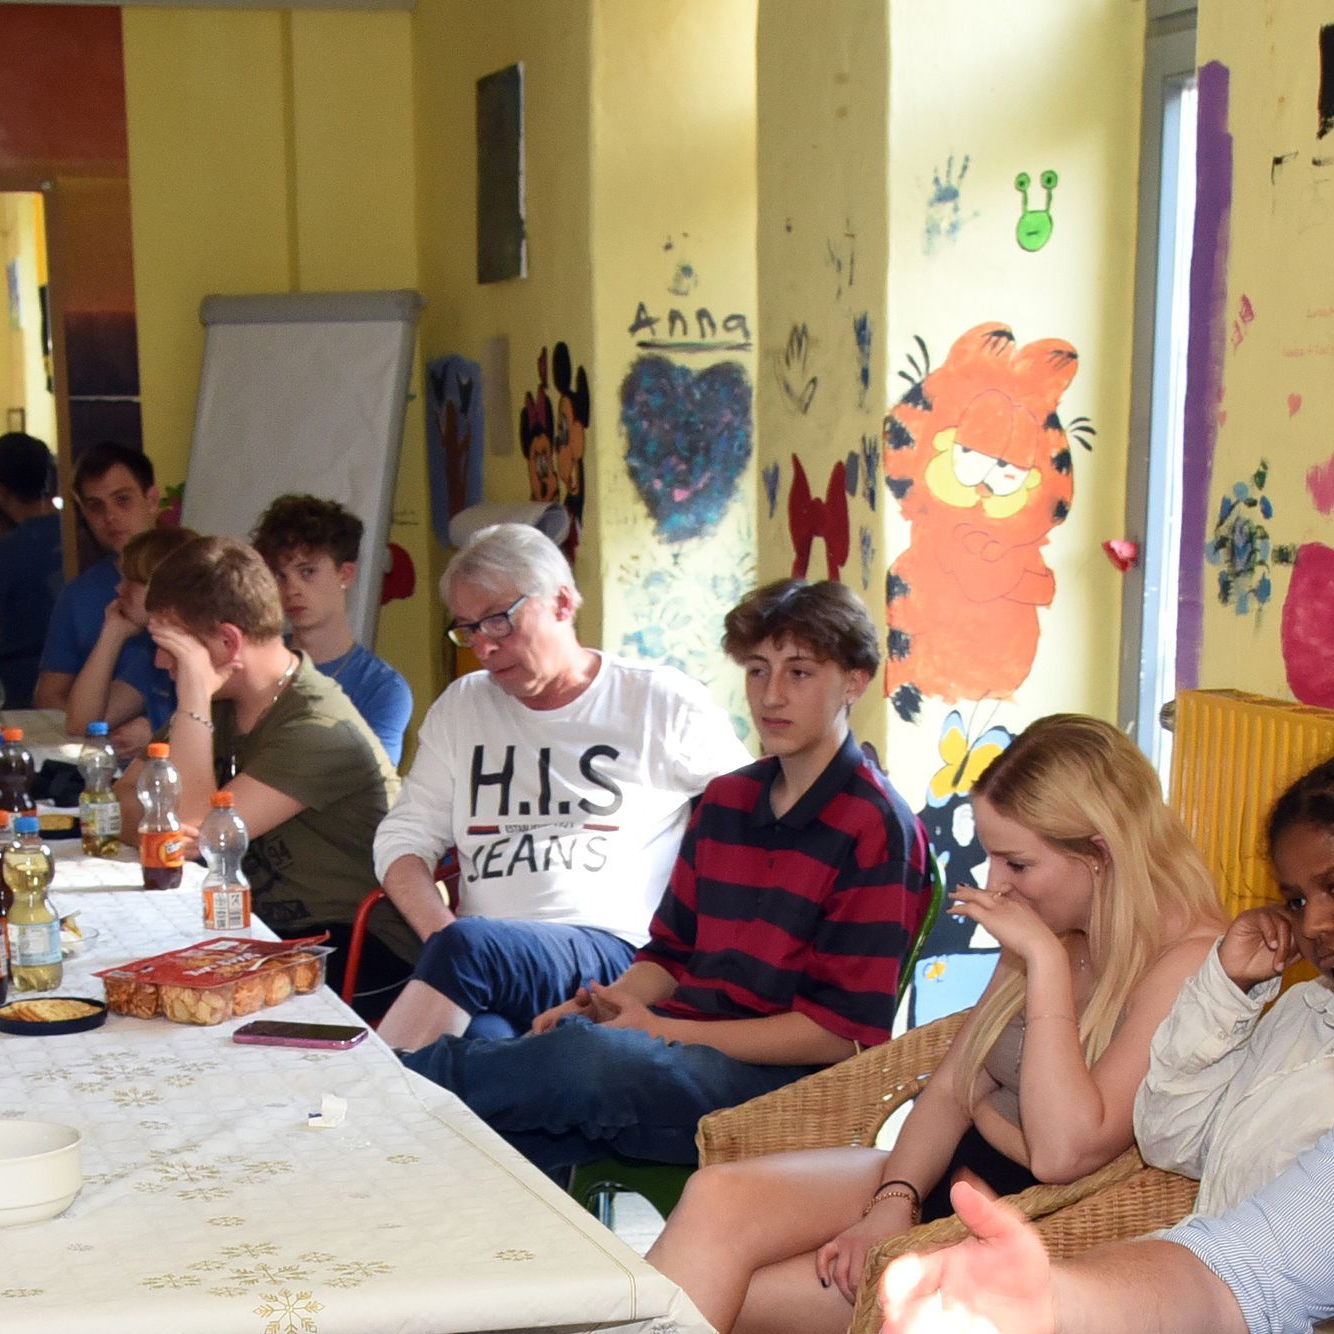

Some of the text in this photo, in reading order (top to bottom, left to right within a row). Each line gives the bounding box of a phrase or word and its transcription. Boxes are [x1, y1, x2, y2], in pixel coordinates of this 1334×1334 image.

[627, 301, 751, 338] Anna
[470, 744, 623, 817] H.I.S
[467, 833, 609, 882] JEANS
